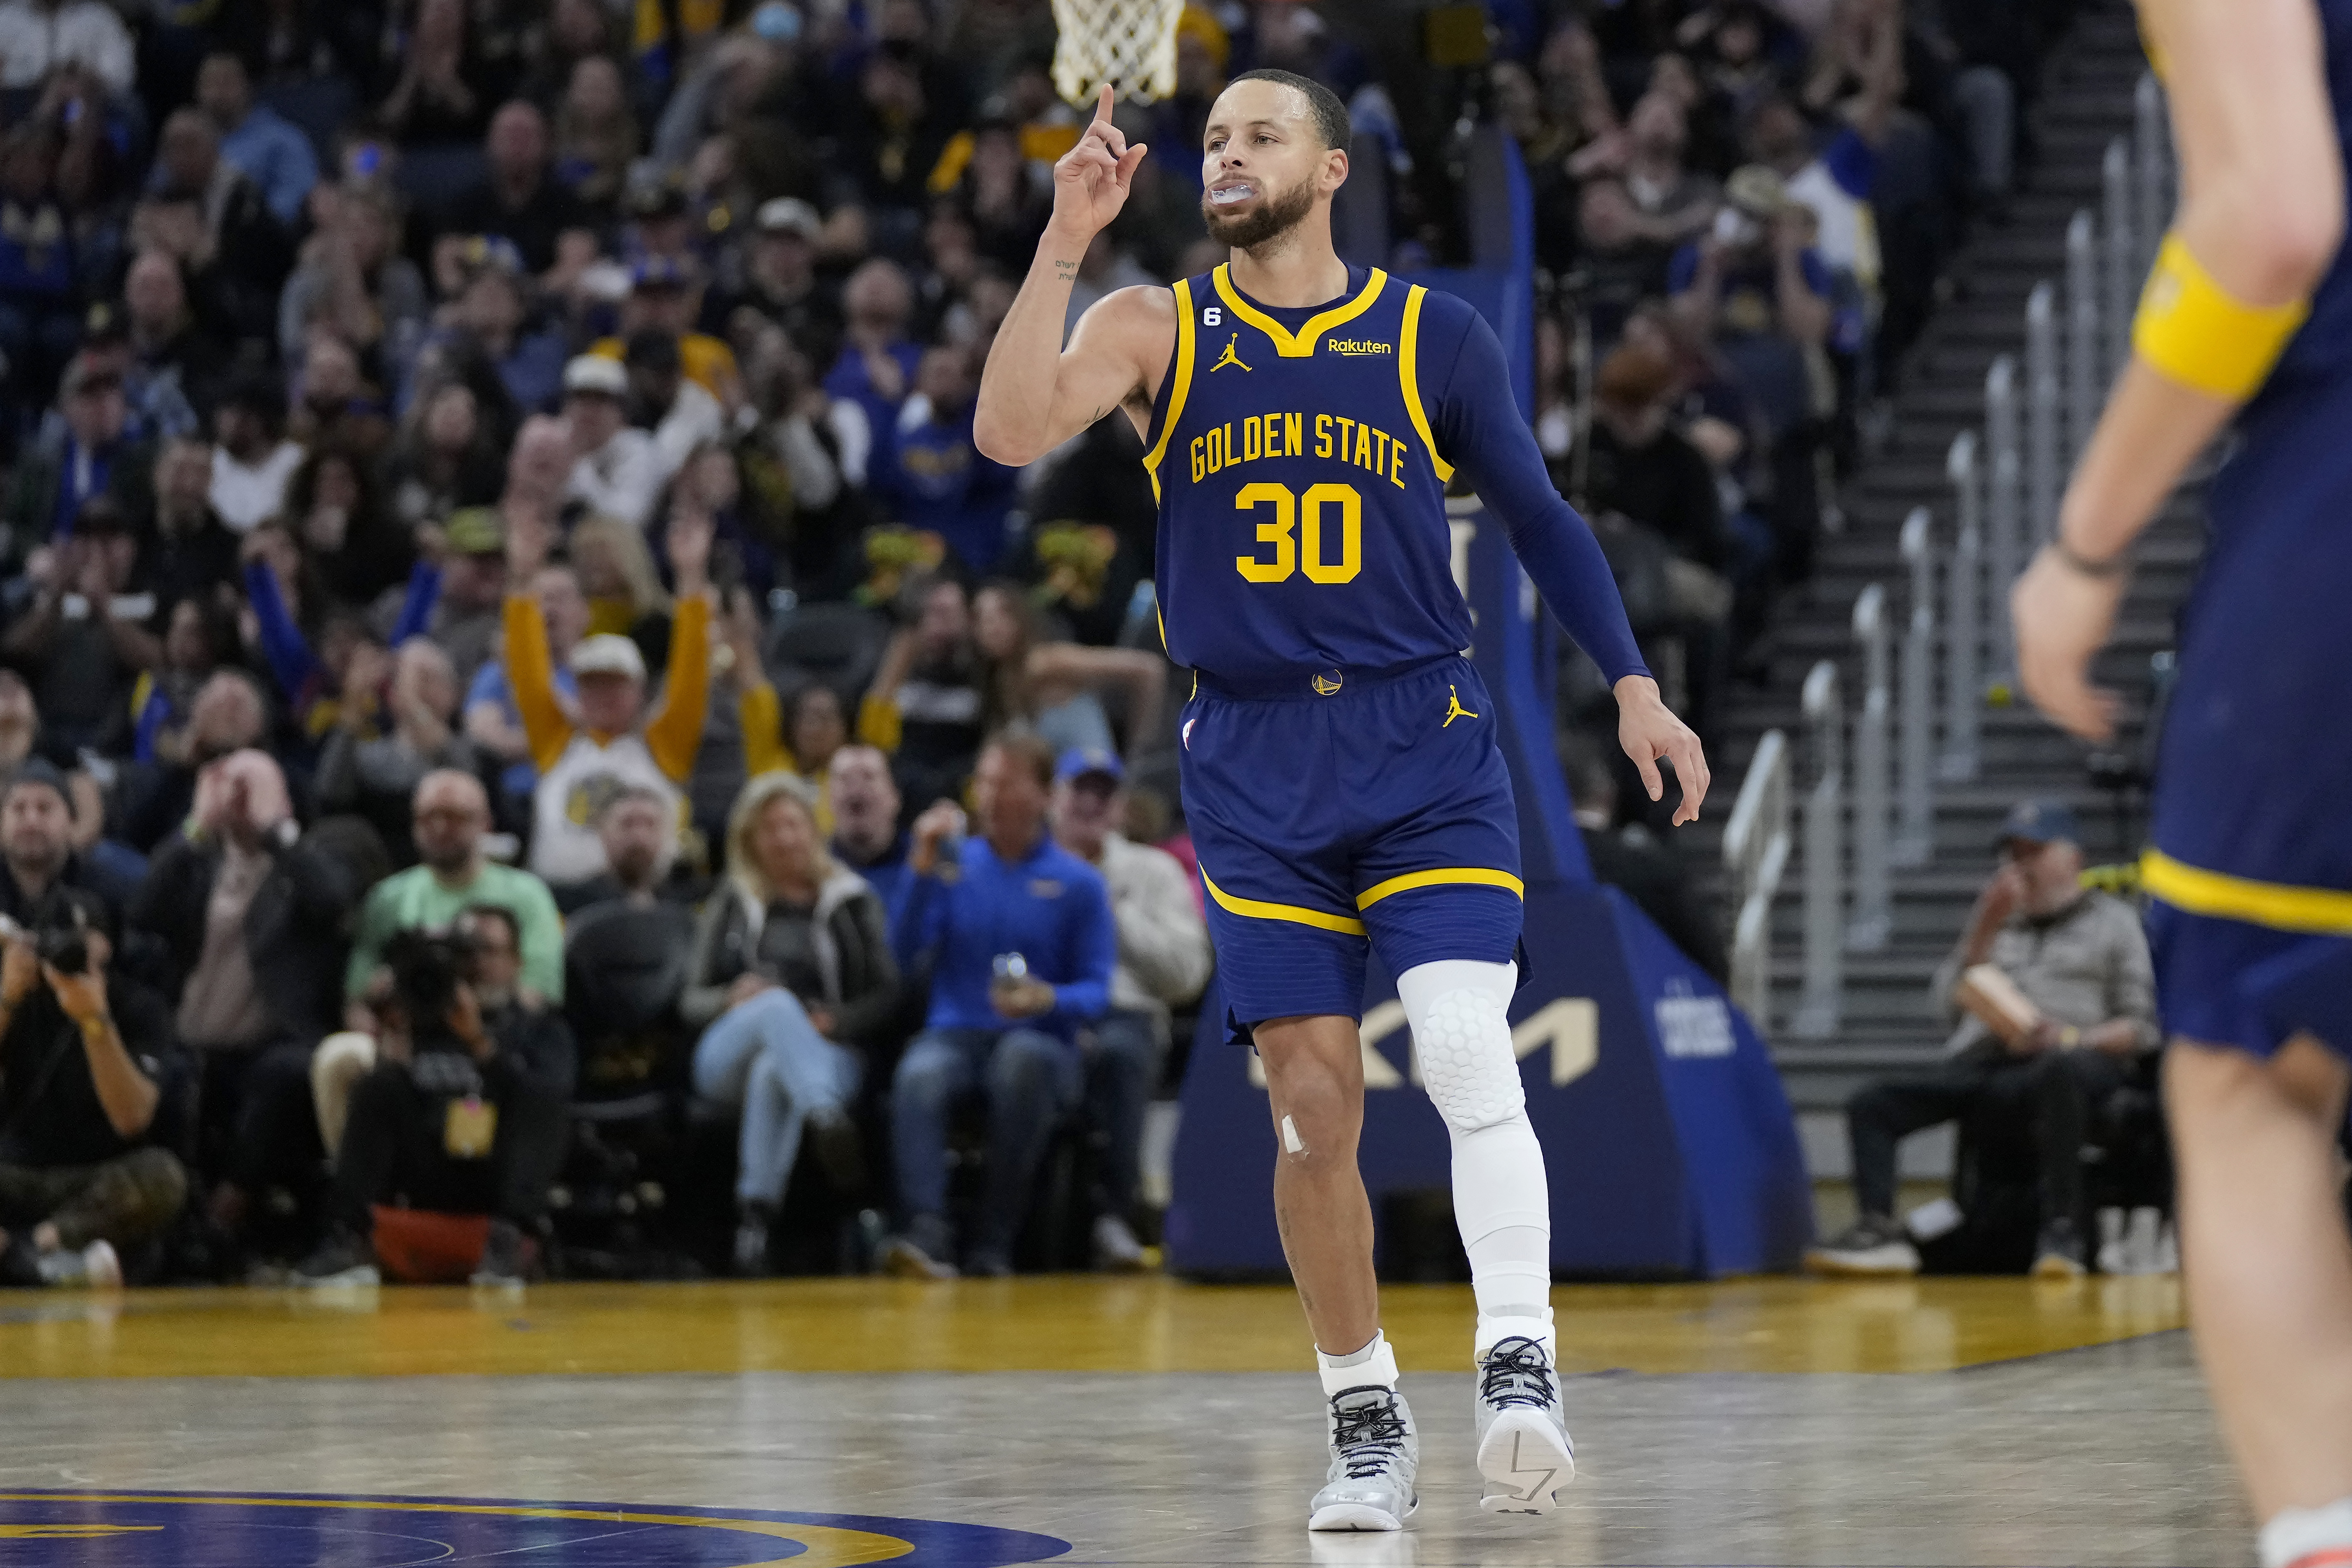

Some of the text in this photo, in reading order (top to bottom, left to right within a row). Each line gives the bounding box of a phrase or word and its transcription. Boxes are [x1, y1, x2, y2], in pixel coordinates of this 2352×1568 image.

[1204, 307, 1221, 326] 6
[1328, 339, 1391, 355] Rakuten
[1190, 413, 1407, 490] GOLDEN STATE
[1235, 483, 1362, 584] 30
